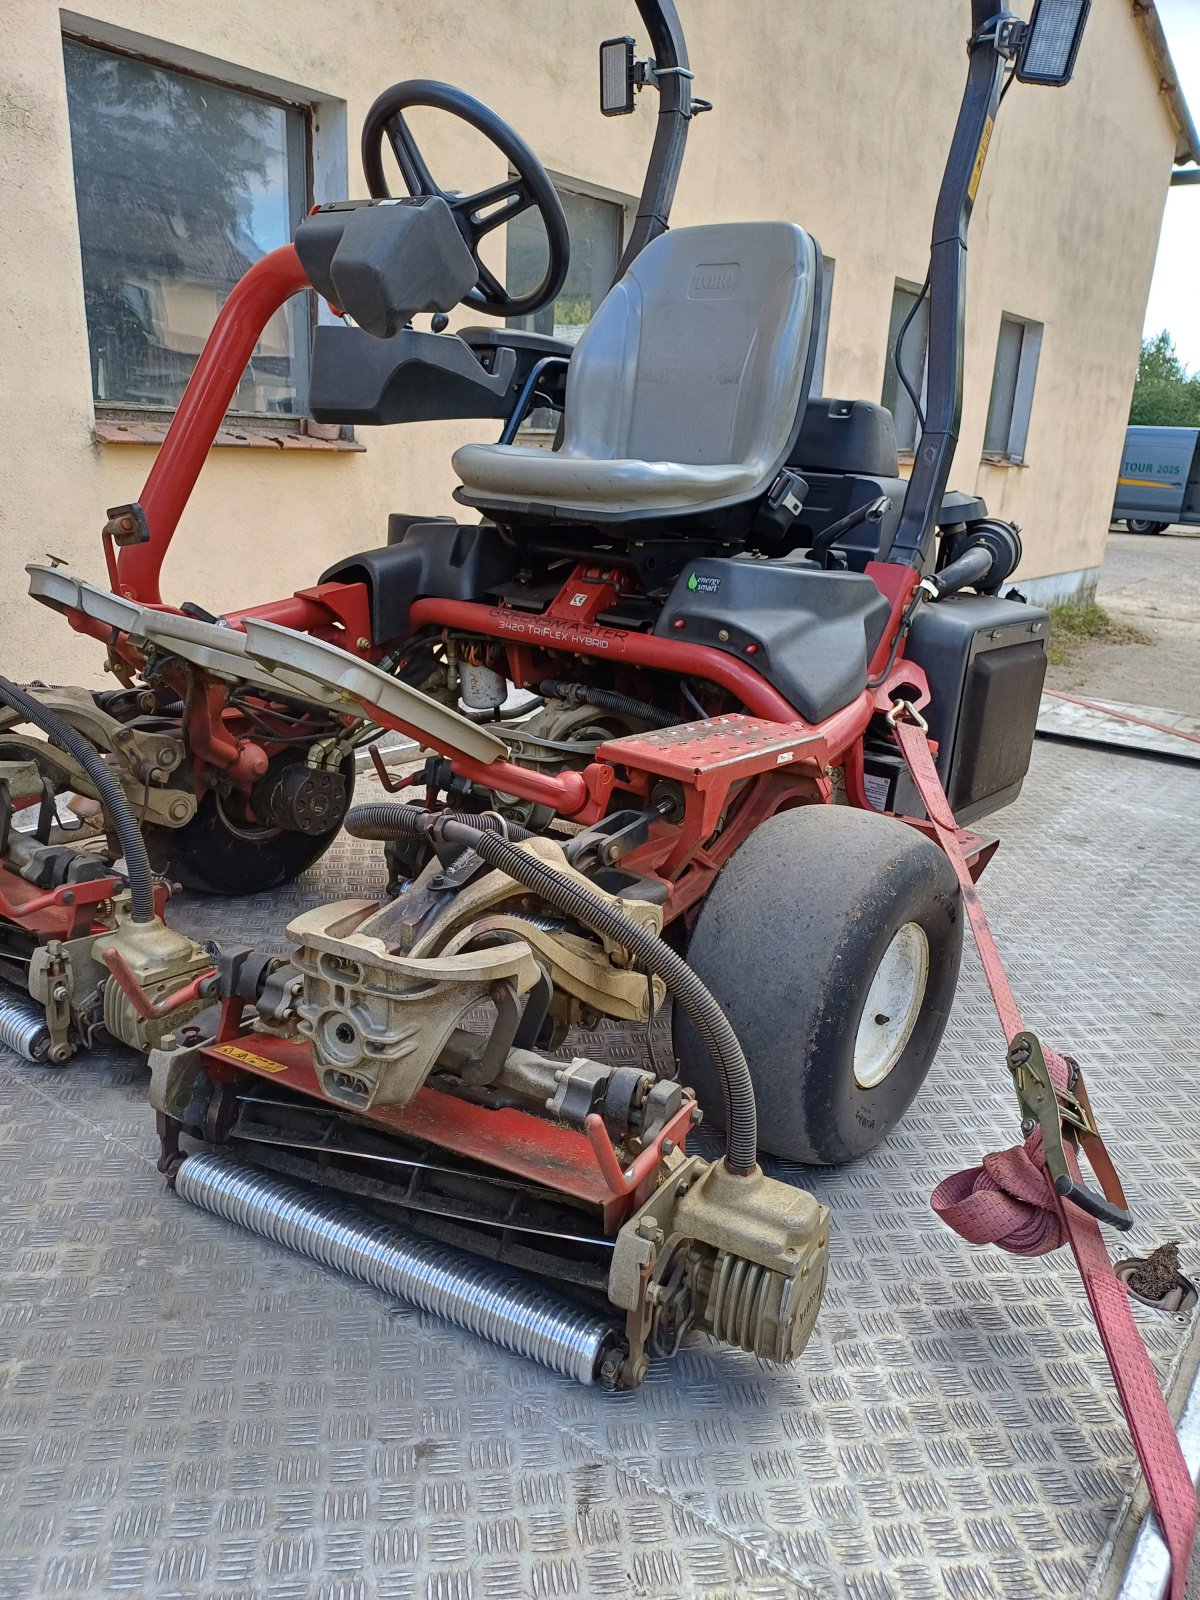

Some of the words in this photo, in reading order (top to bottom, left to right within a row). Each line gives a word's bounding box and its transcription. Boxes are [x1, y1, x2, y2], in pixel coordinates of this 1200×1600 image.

[1124, 462, 1153, 473] TOUR
[1156, 464, 1180, 475] 2025
[697, 577, 720, 586] energy
[697, 584, 718, 592] smart
[489, 608, 629, 641] GREENSMASTER
[499, 621, 525, 632] 3420
[571, 635, 609, 649] HYBRID
